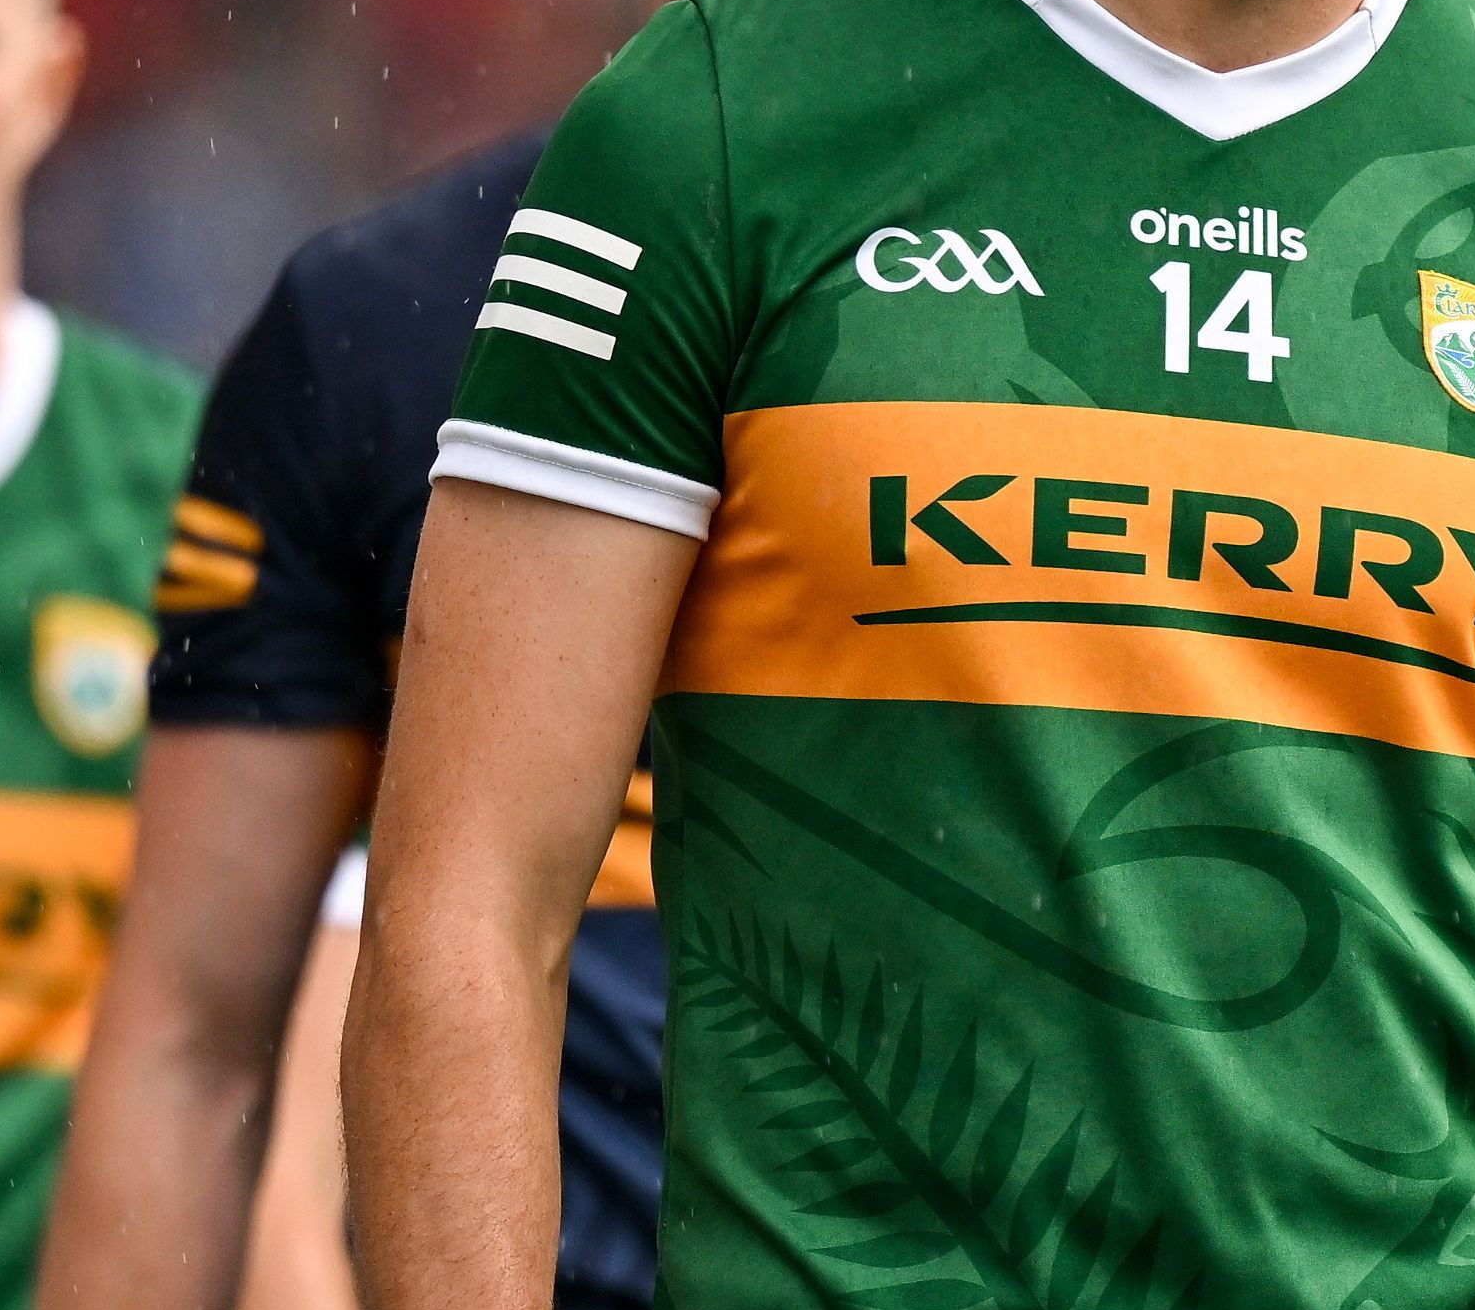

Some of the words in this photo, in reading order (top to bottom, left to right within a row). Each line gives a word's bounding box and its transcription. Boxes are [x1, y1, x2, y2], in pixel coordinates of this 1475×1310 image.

[855, 226, 1046, 297] GAA
[1130, 206, 1308, 262] o'neills
[1148, 260, 1291, 383] 14
